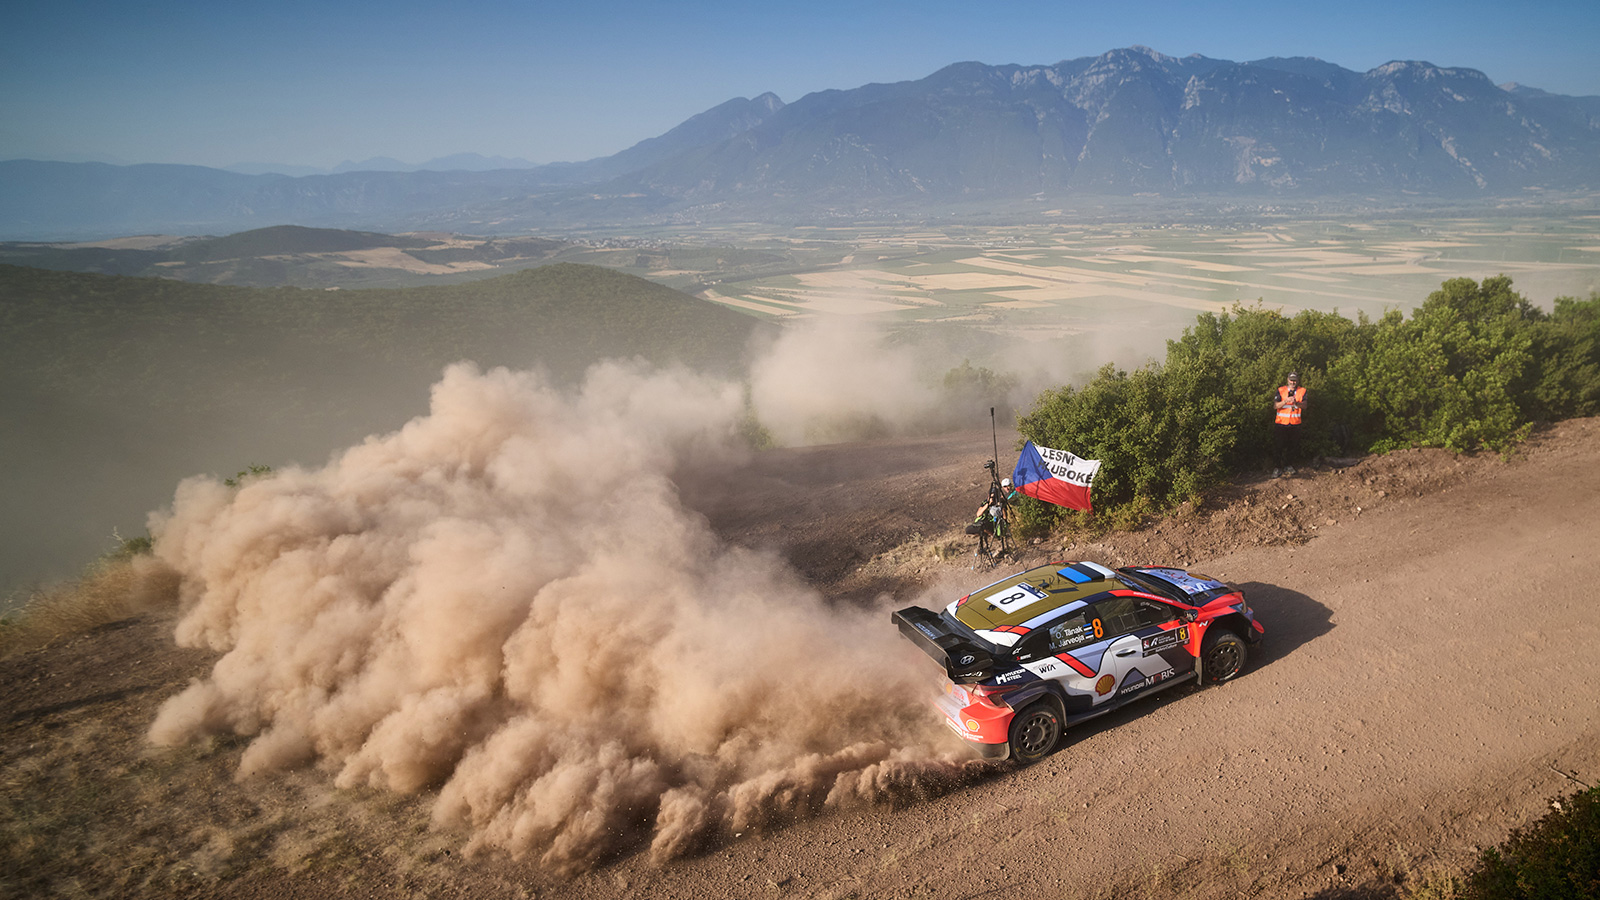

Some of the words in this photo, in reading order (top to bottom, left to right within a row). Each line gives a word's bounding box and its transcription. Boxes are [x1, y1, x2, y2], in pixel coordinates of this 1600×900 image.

[1042, 448, 1075, 465] LESNÍ
[999, 592, 1026, 605] 8
[1055, 631, 1064, 639] O.
[1092, 618, 1104, 639] 8
[1179, 627, 1186, 640] 8
[1048, 642, 1058, 650] M.
[1006, 674, 1022, 682] STEEL
